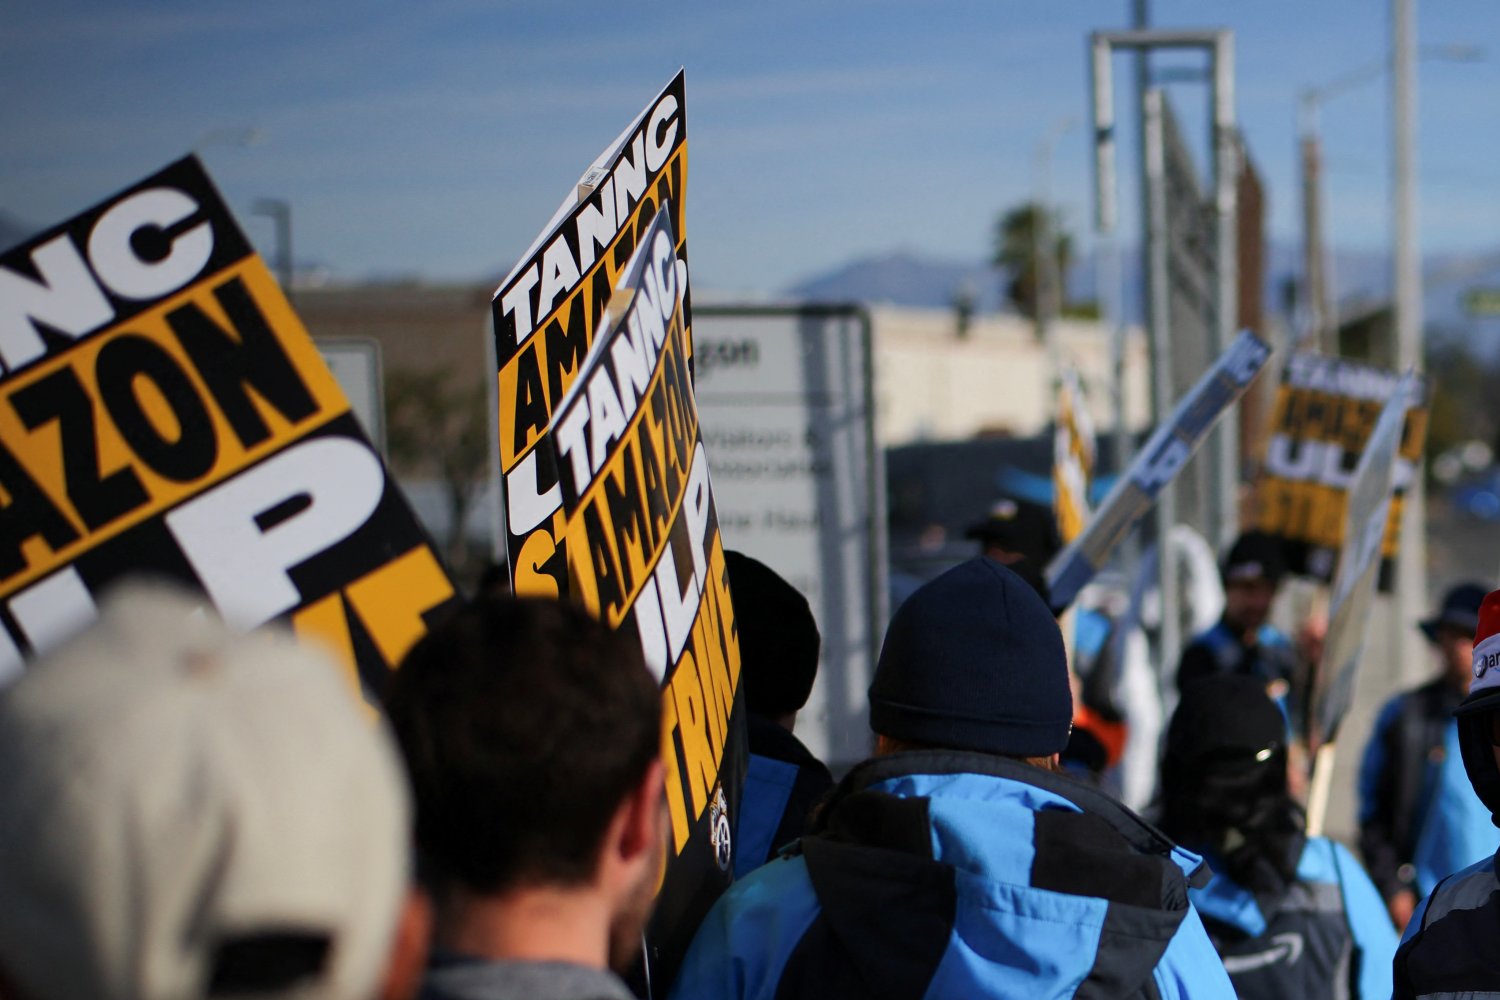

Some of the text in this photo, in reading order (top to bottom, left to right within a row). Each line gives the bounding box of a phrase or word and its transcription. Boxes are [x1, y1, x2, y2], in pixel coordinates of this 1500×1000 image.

[502, 94, 679, 346] TANNC
[556, 229, 674, 497] TANNC
[658, 528, 741, 858] TRIKE
